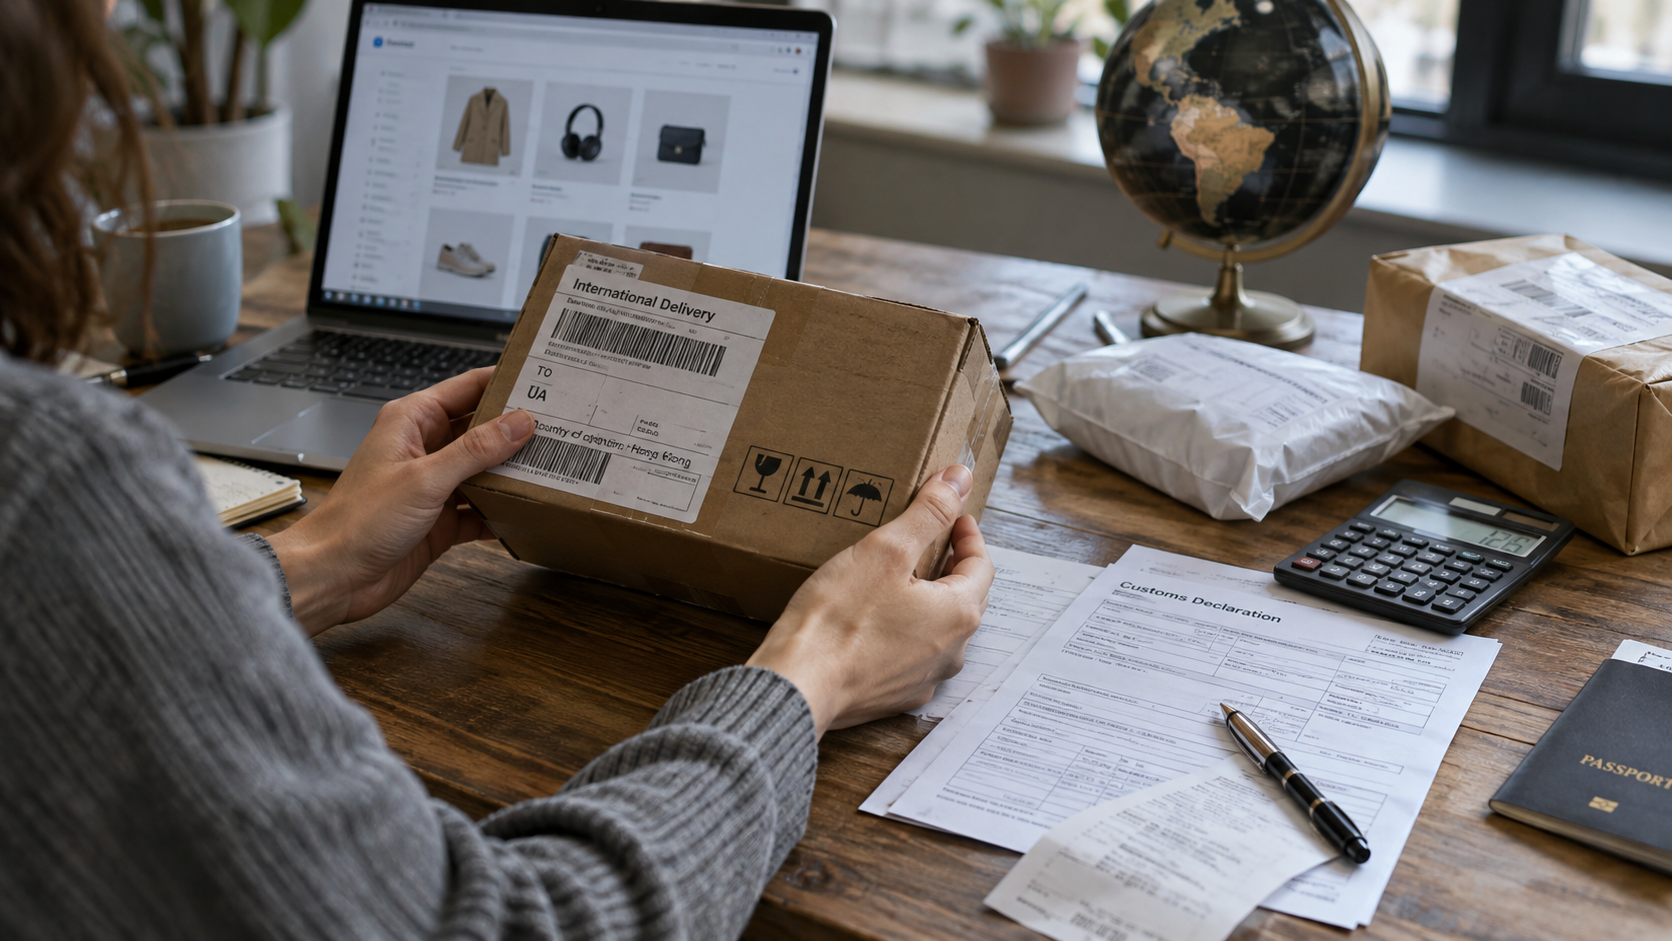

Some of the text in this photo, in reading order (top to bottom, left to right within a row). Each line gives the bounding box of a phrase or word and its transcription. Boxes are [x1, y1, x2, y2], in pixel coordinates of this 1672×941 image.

[573, 278, 658, 308] International
[660, 298, 716, 323] Delivery
[537, 365, 553, 378] TO
[527, 385, 547, 402] UA
[1120, 581, 1188, 602] Customs
[1192, 597, 1282, 623] Declaration
[1580, 754, 1672, 790] PASSPORT
